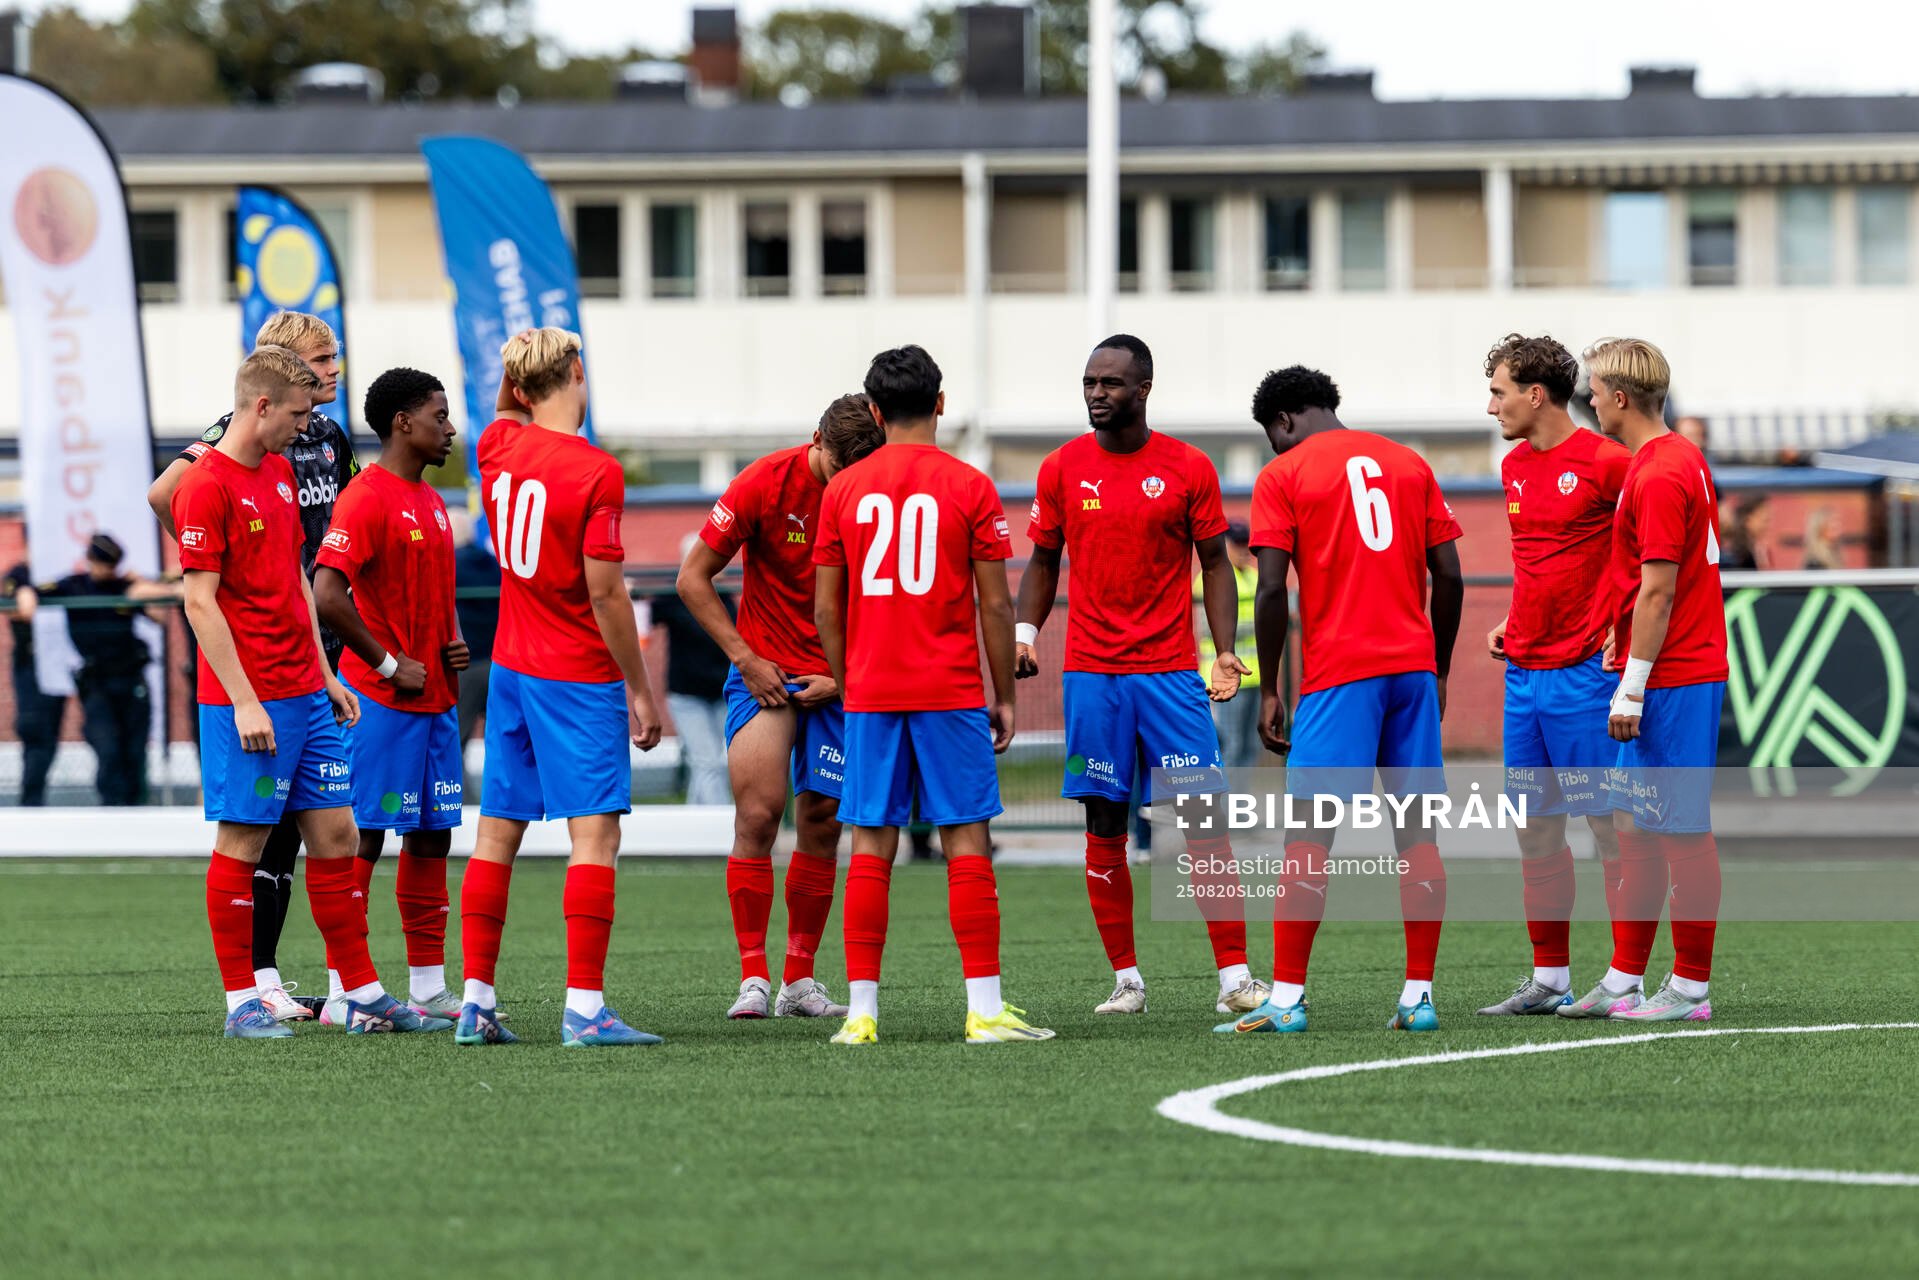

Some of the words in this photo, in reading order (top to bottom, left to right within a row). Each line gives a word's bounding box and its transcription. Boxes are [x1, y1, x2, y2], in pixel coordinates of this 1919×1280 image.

[1082, 498, 1102, 511] XXL
[1346, 455, 1393, 552] 6
[249, 518, 264, 532] XXL
[491, 471, 547, 580] 10
[410, 529, 424, 542] XXL
[787, 531, 806, 544] XXL
[856, 493, 939, 597] 20
[1087, 757, 1114, 775] Solid
[1161, 753, 1200, 770] Fibio
[1508, 767, 1535, 781] Solid
[1557, 770, 1589, 787] Fibio
[434, 779, 462, 796] Fibio
